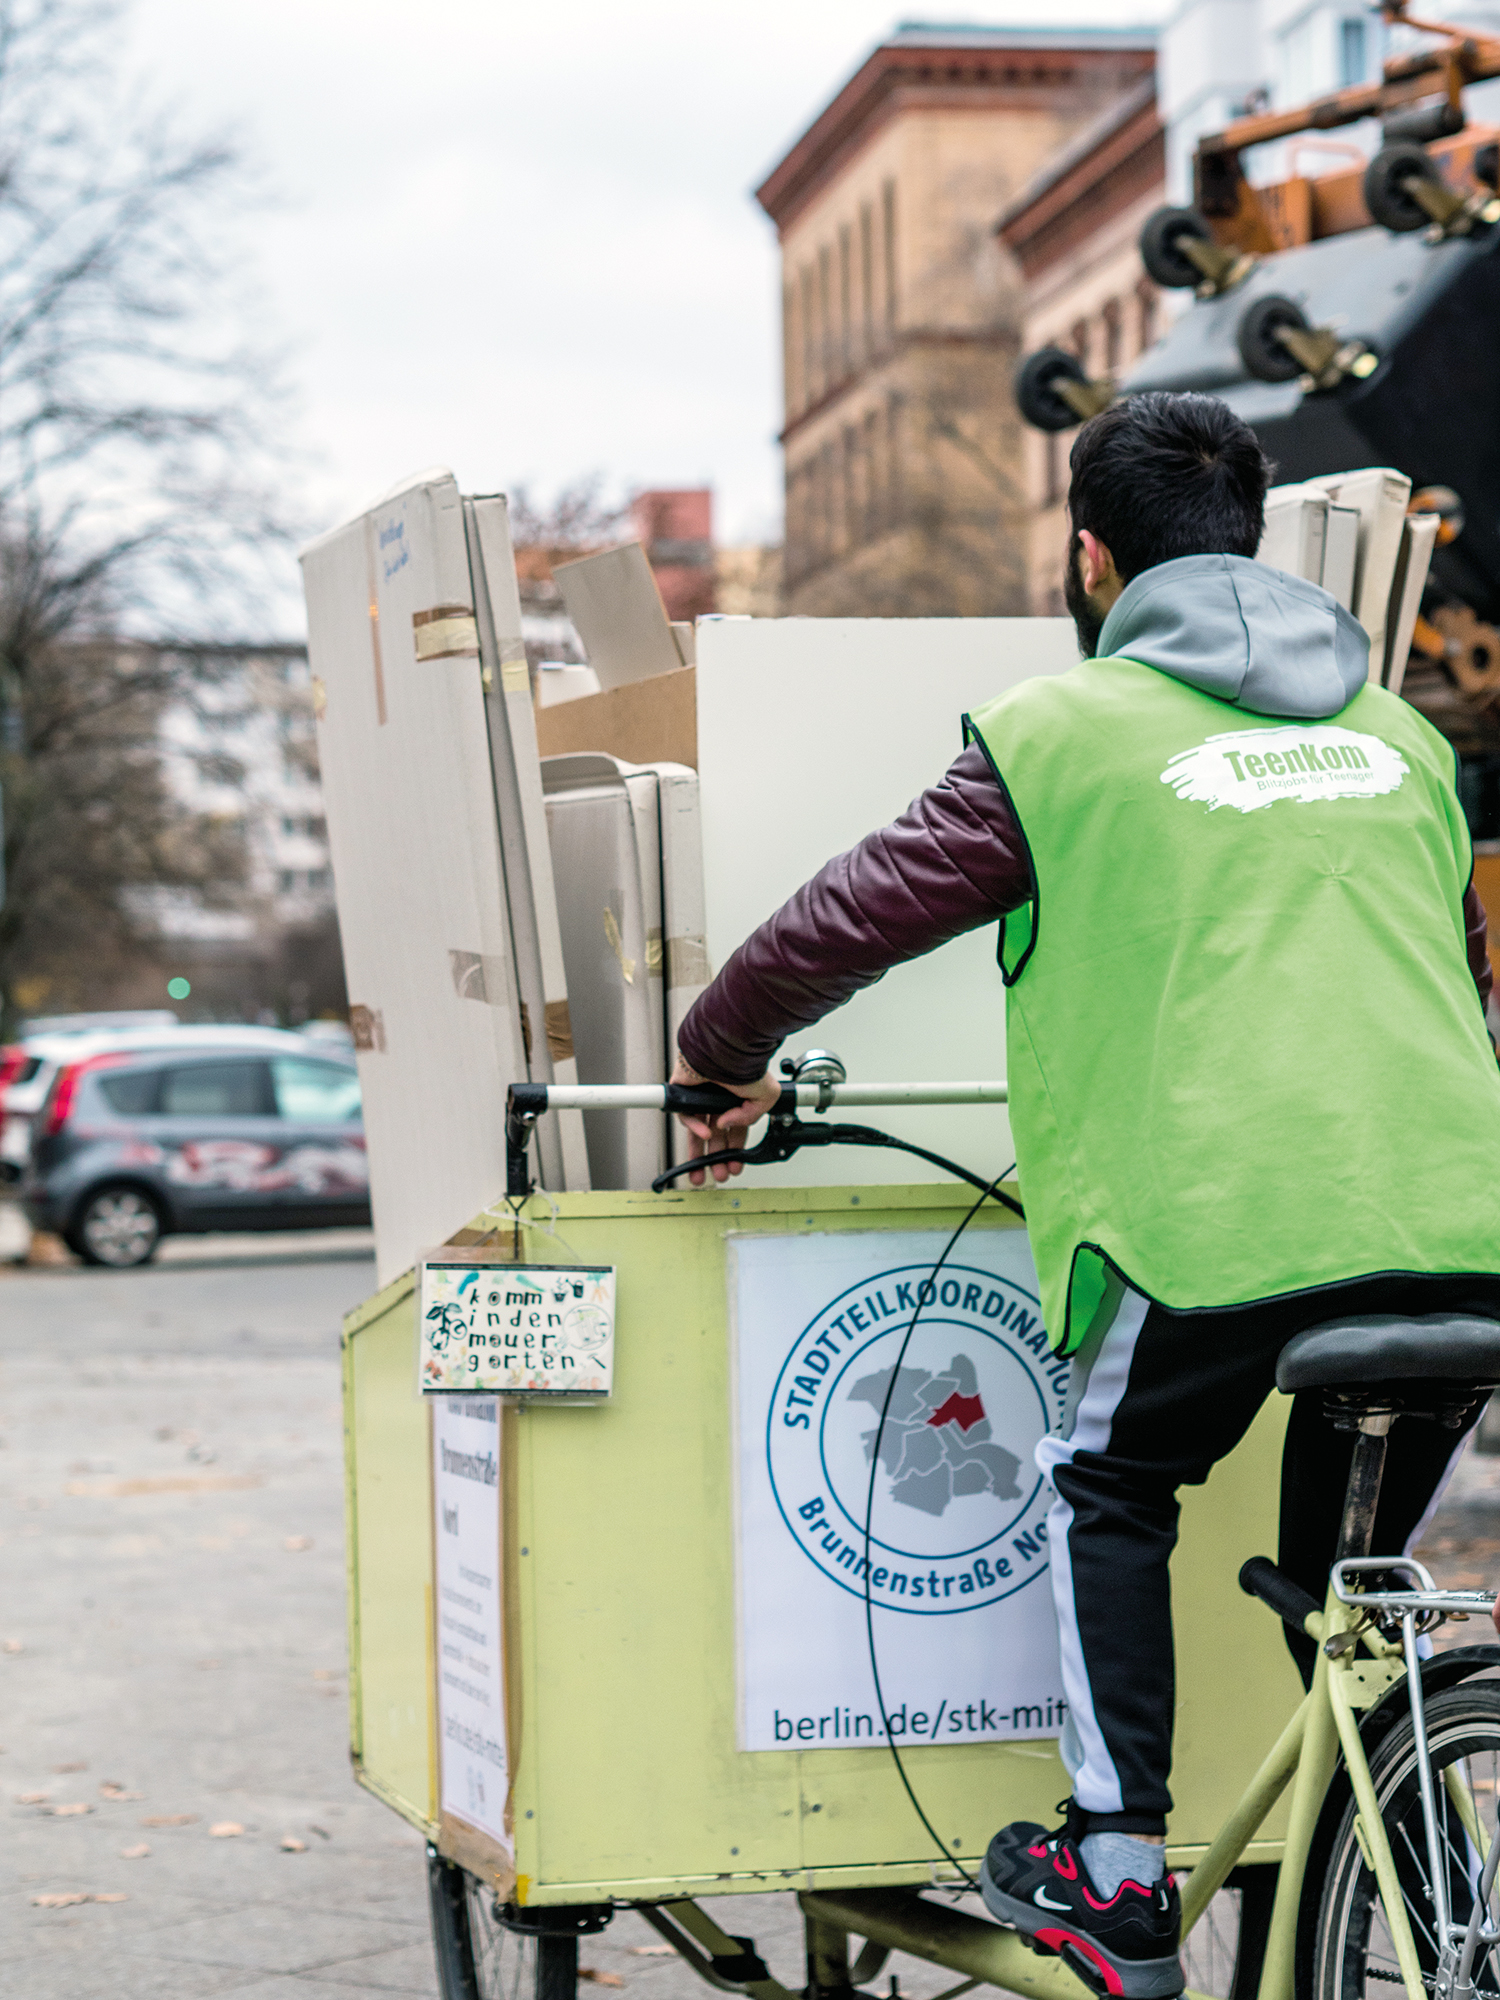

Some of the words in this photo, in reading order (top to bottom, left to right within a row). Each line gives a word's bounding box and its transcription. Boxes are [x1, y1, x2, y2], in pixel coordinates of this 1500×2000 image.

[1222, 743, 1371, 783] TeenKom
[1256, 776, 1308, 791] Blitzjobs
[1309, 773, 1324, 784] für
[1326, 771, 1375, 783] Teenager
[469, 1288, 542, 1306] komm
[468, 1333, 557, 1349] mauer
[468, 1351, 575, 1373] garten
[783, 1279, 1070, 1430] STADTTEILKOORDINAIO
[798, 1496, 1013, 1598] Brunnenstraße
